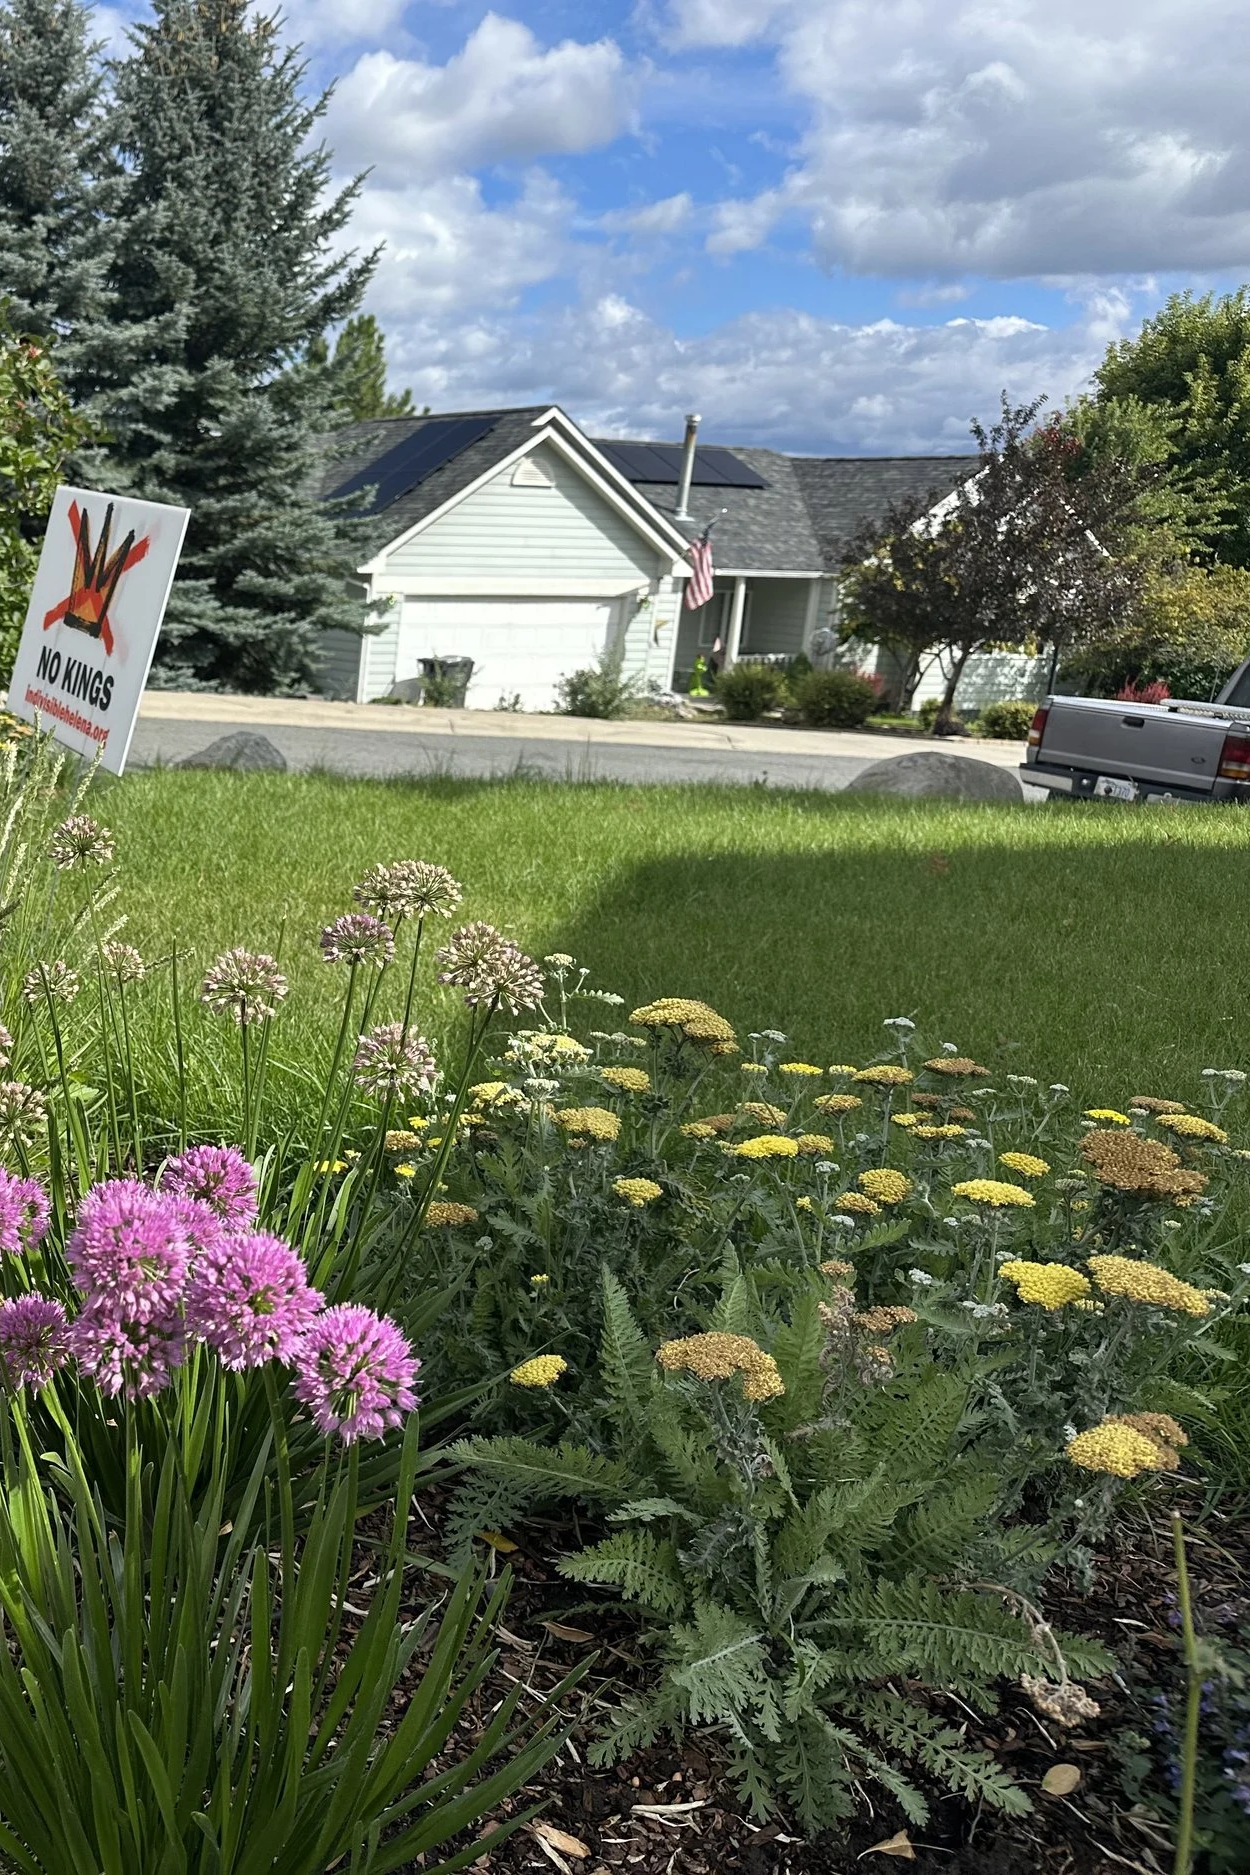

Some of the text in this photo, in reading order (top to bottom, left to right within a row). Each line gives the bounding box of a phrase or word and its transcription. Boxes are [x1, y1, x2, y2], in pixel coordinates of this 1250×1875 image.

[36, 645, 114, 711] NO KINGS
[25, 684, 110, 749] indivisiblehelena.org
